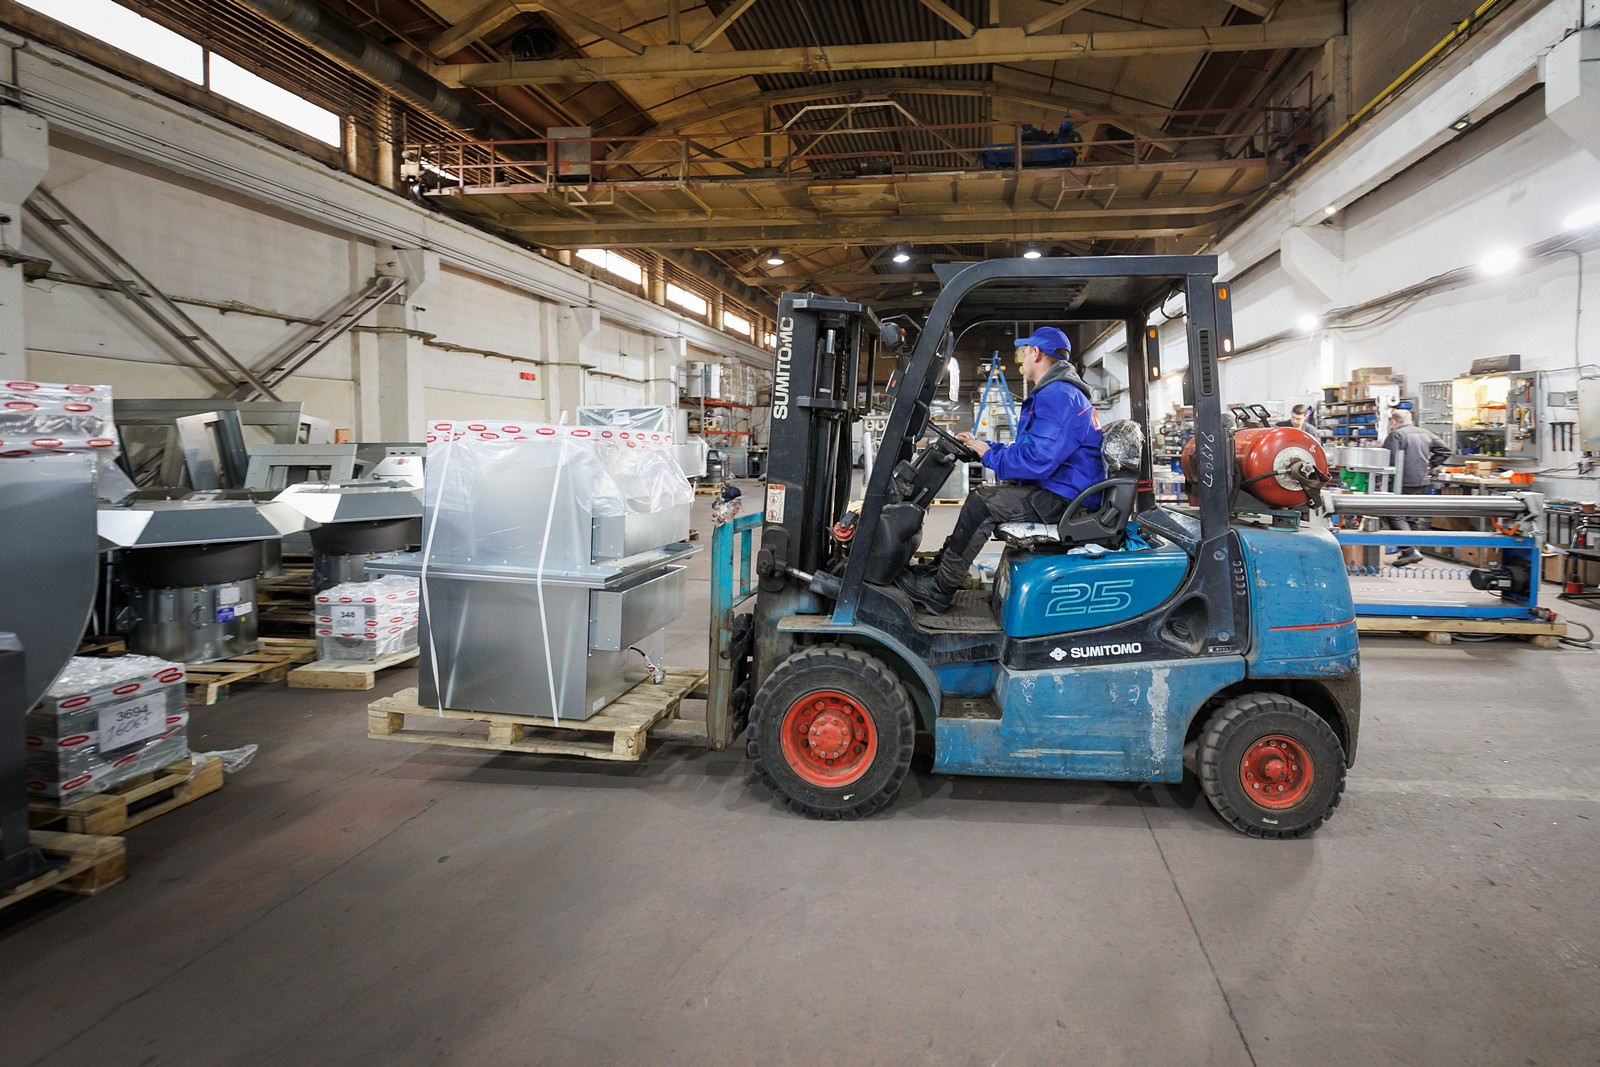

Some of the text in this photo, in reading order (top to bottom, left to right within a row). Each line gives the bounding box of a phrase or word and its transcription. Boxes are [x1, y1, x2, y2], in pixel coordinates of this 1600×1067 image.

[1045, 579, 1134, 617] 25
[1070, 642, 1142, 659] SUMITOMO
[116, 703, 149, 721] 3694
